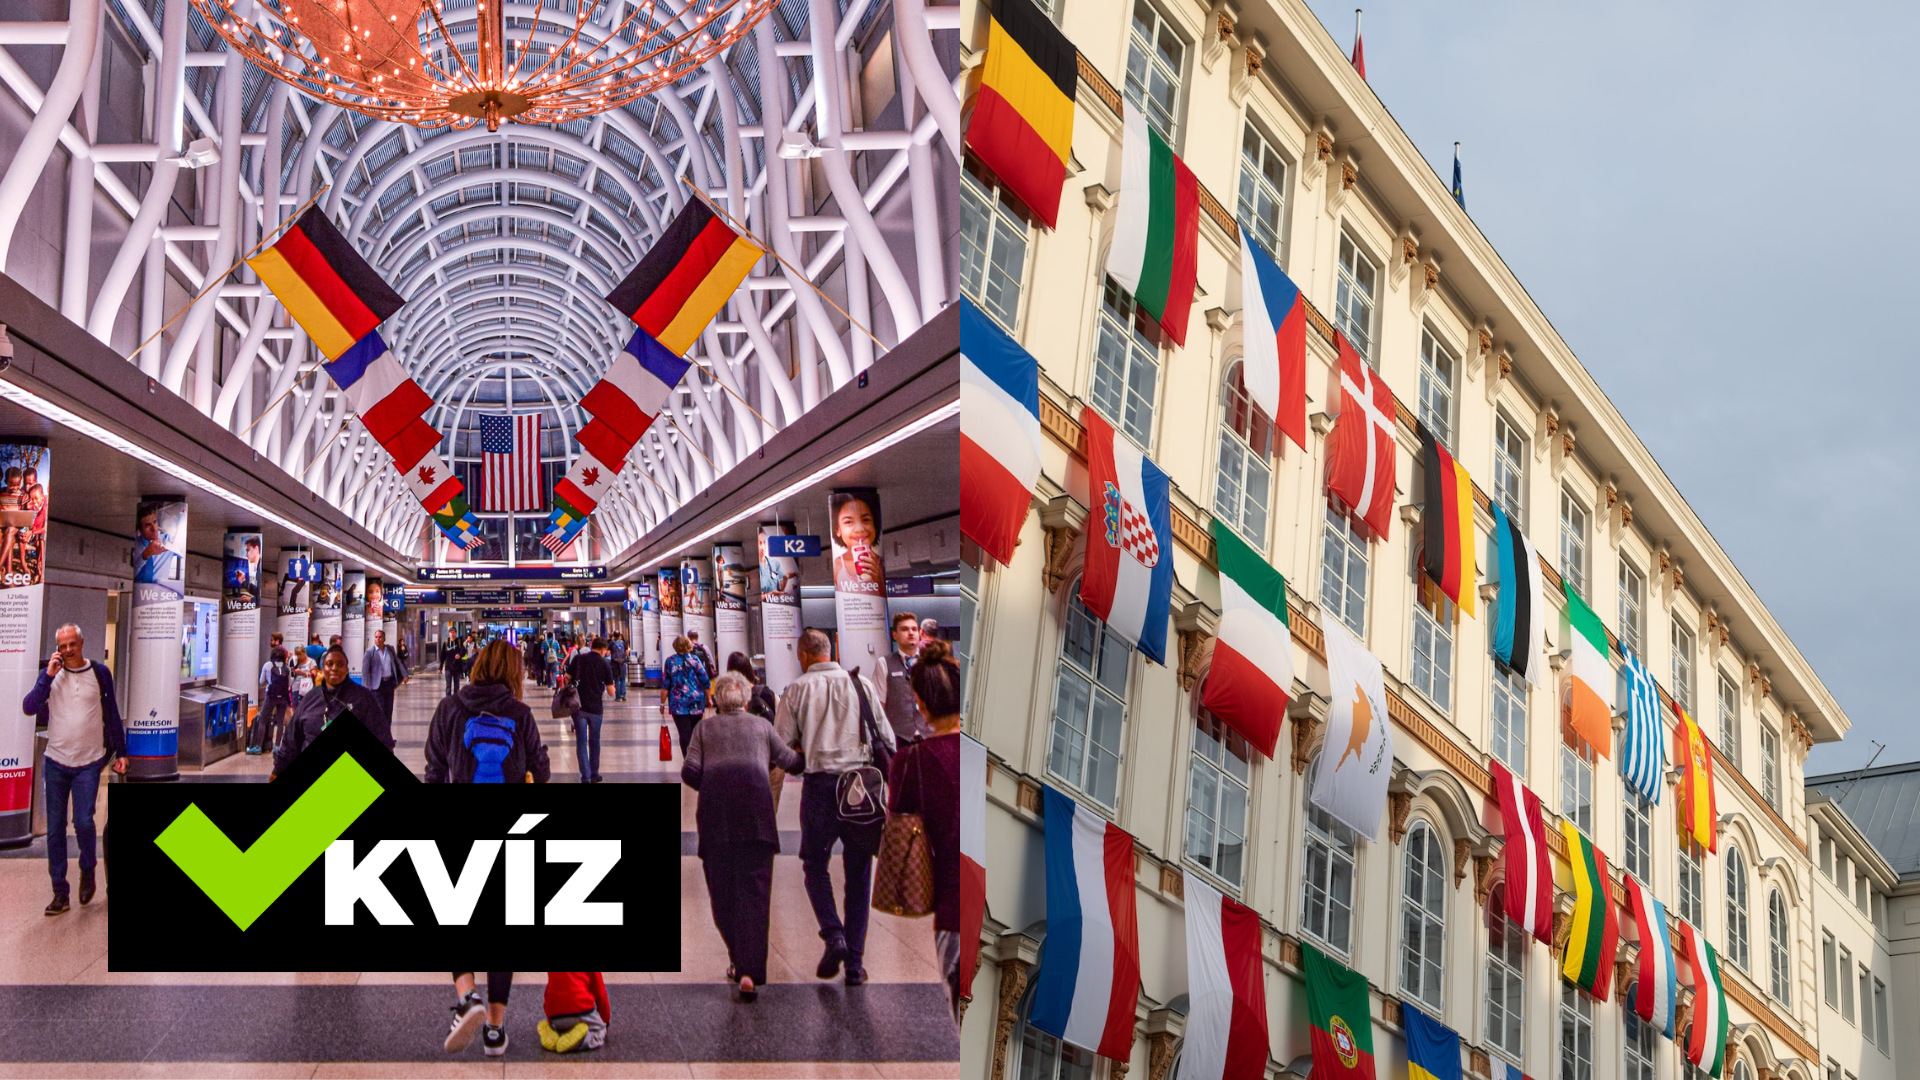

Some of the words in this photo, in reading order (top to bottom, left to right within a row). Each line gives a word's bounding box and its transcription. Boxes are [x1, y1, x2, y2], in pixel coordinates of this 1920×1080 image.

[784, 540, 806, 553] K2
[4, 572, 32, 586] see
[840, 580, 859, 592] We
[861, 582, 879, 591] see
[140, 589, 158, 600] We
[160, 592, 177, 600] see
[765, 594, 779, 603] We
[227, 600, 241, 609] We
[0, 758, 18, 766] ON
